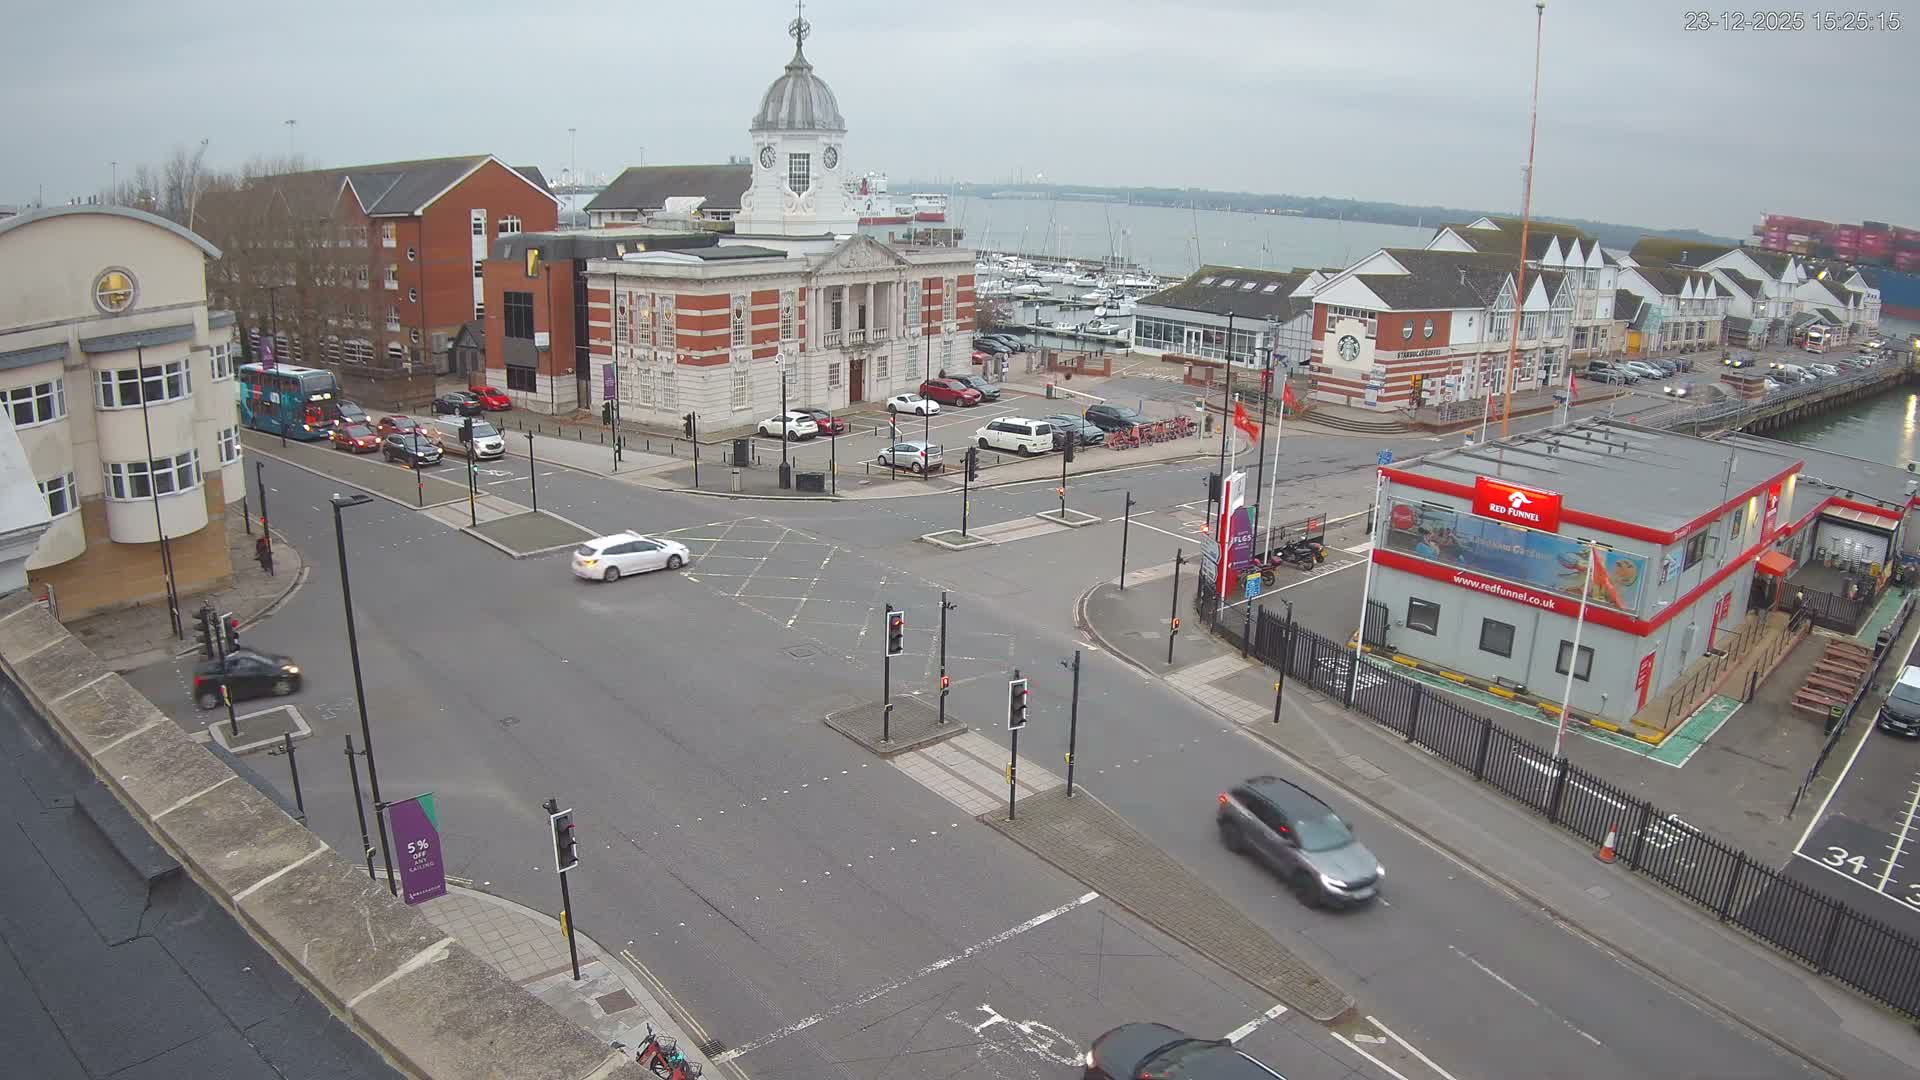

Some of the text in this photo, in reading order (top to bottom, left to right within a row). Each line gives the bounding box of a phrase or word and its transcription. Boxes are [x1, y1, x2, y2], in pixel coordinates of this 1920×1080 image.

[1489, 503, 1540, 522] RED FUNNEL
[1453, 575, 1555, 609] www.redfunnel.co.uk
[413, 851, 427, 860] OFF
[414, 858, 427, 866] ANY
[1822, 846, 1869, 874] 34
[408, 861, 435, 872] SAILING
